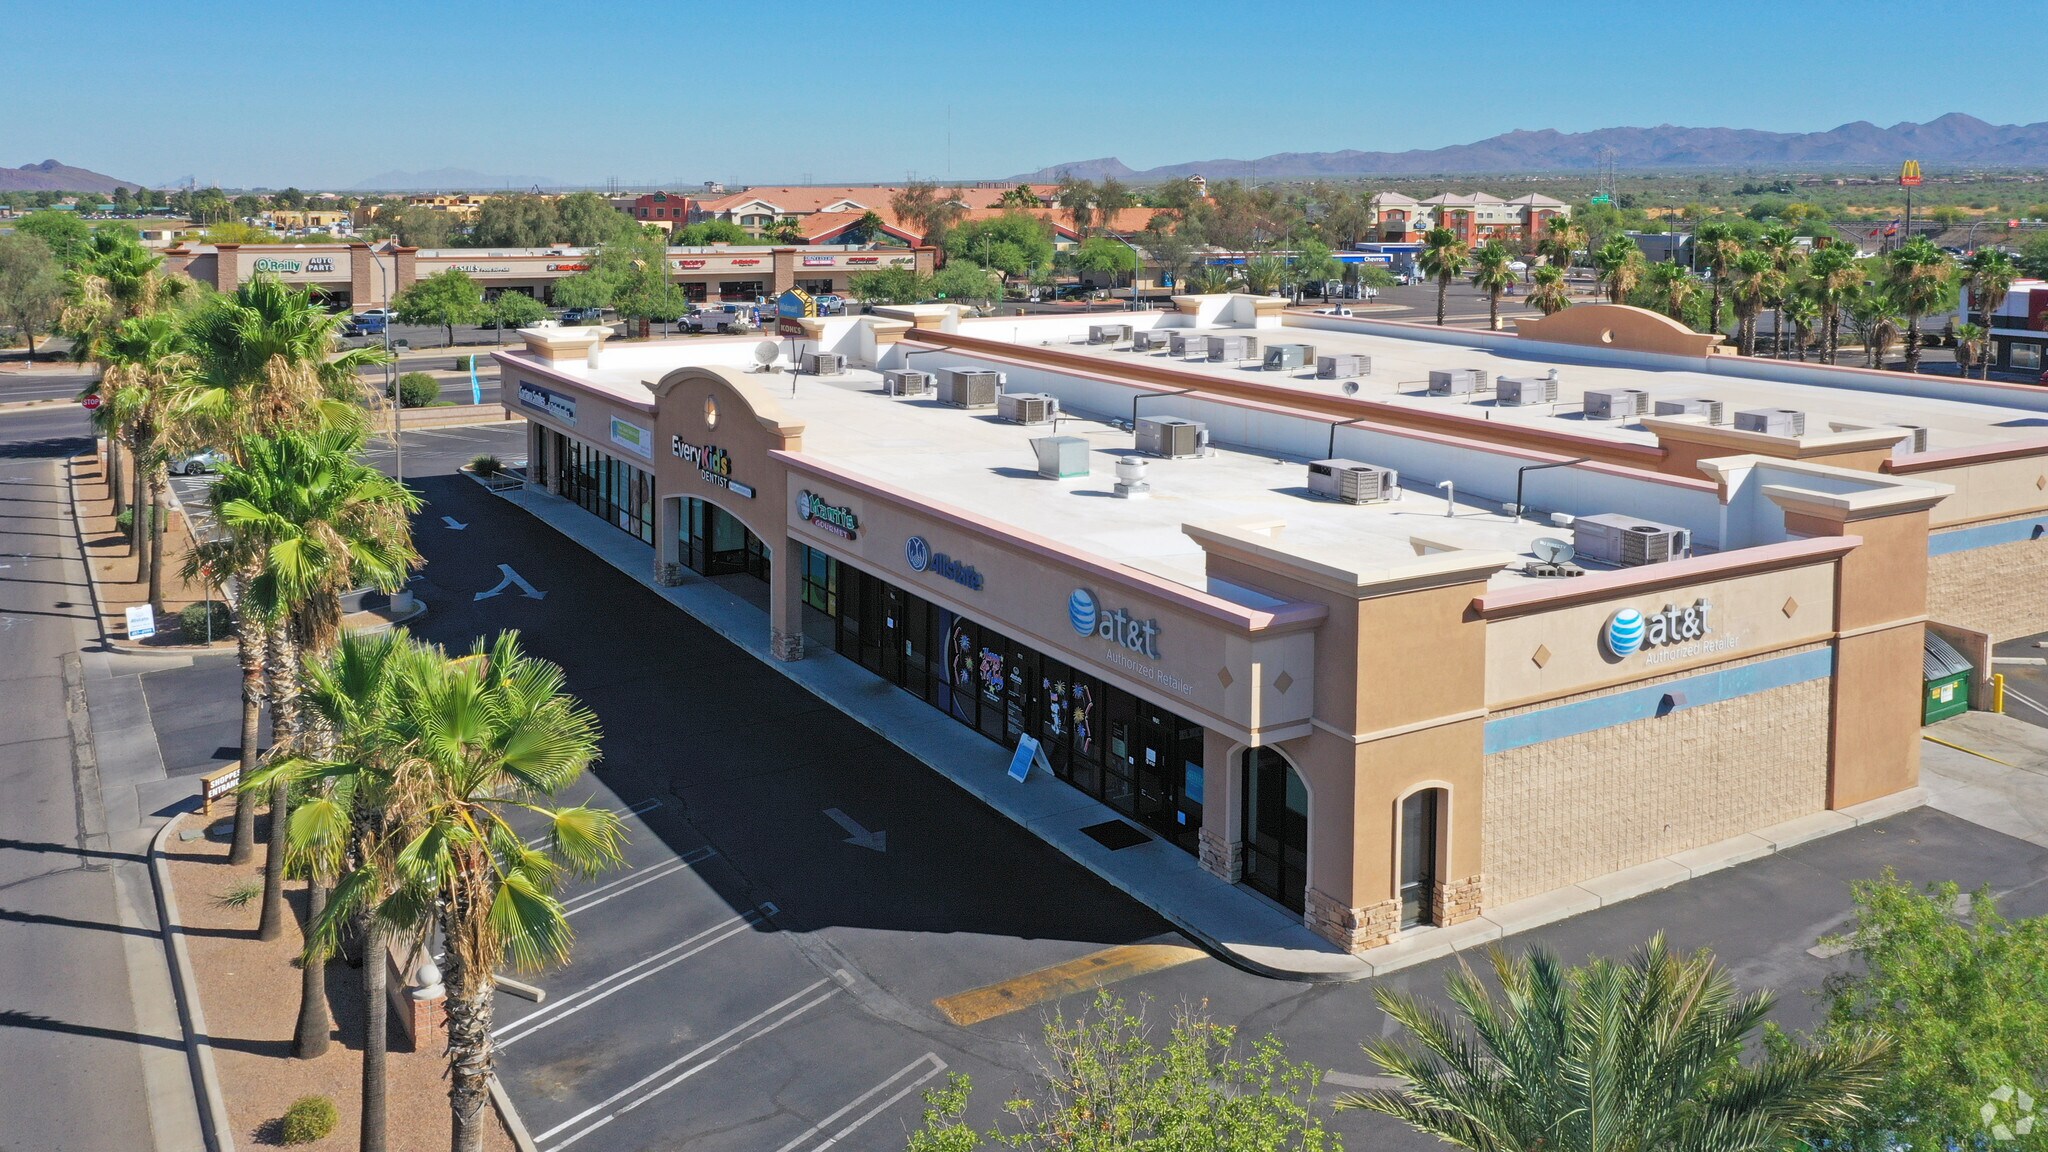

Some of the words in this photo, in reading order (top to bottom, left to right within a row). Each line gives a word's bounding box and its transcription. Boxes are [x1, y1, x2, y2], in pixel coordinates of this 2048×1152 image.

[256, 257, 302, 272] O'Reilly
[781, 324, 802, 335] KOHL'S
[701, 469, 728, 488] DENTIST
[809, 494, 855, 530] Mantis
[815, 520, 848, 539] GOURMET
[930, 552, 984, 592] Allstate
[1099, 608, 1160, 660] at&t
[1649, 598, 1714, 646] at&t
[1645, 644, 1700, 665] Authorized
[1704, 636, 1740, 655] Retailer
[1106, 649, 1154, 679] Authorized
[1157, 669, 1194, 696] Retailer
[208, 778, 240, 798] ENTRANC
